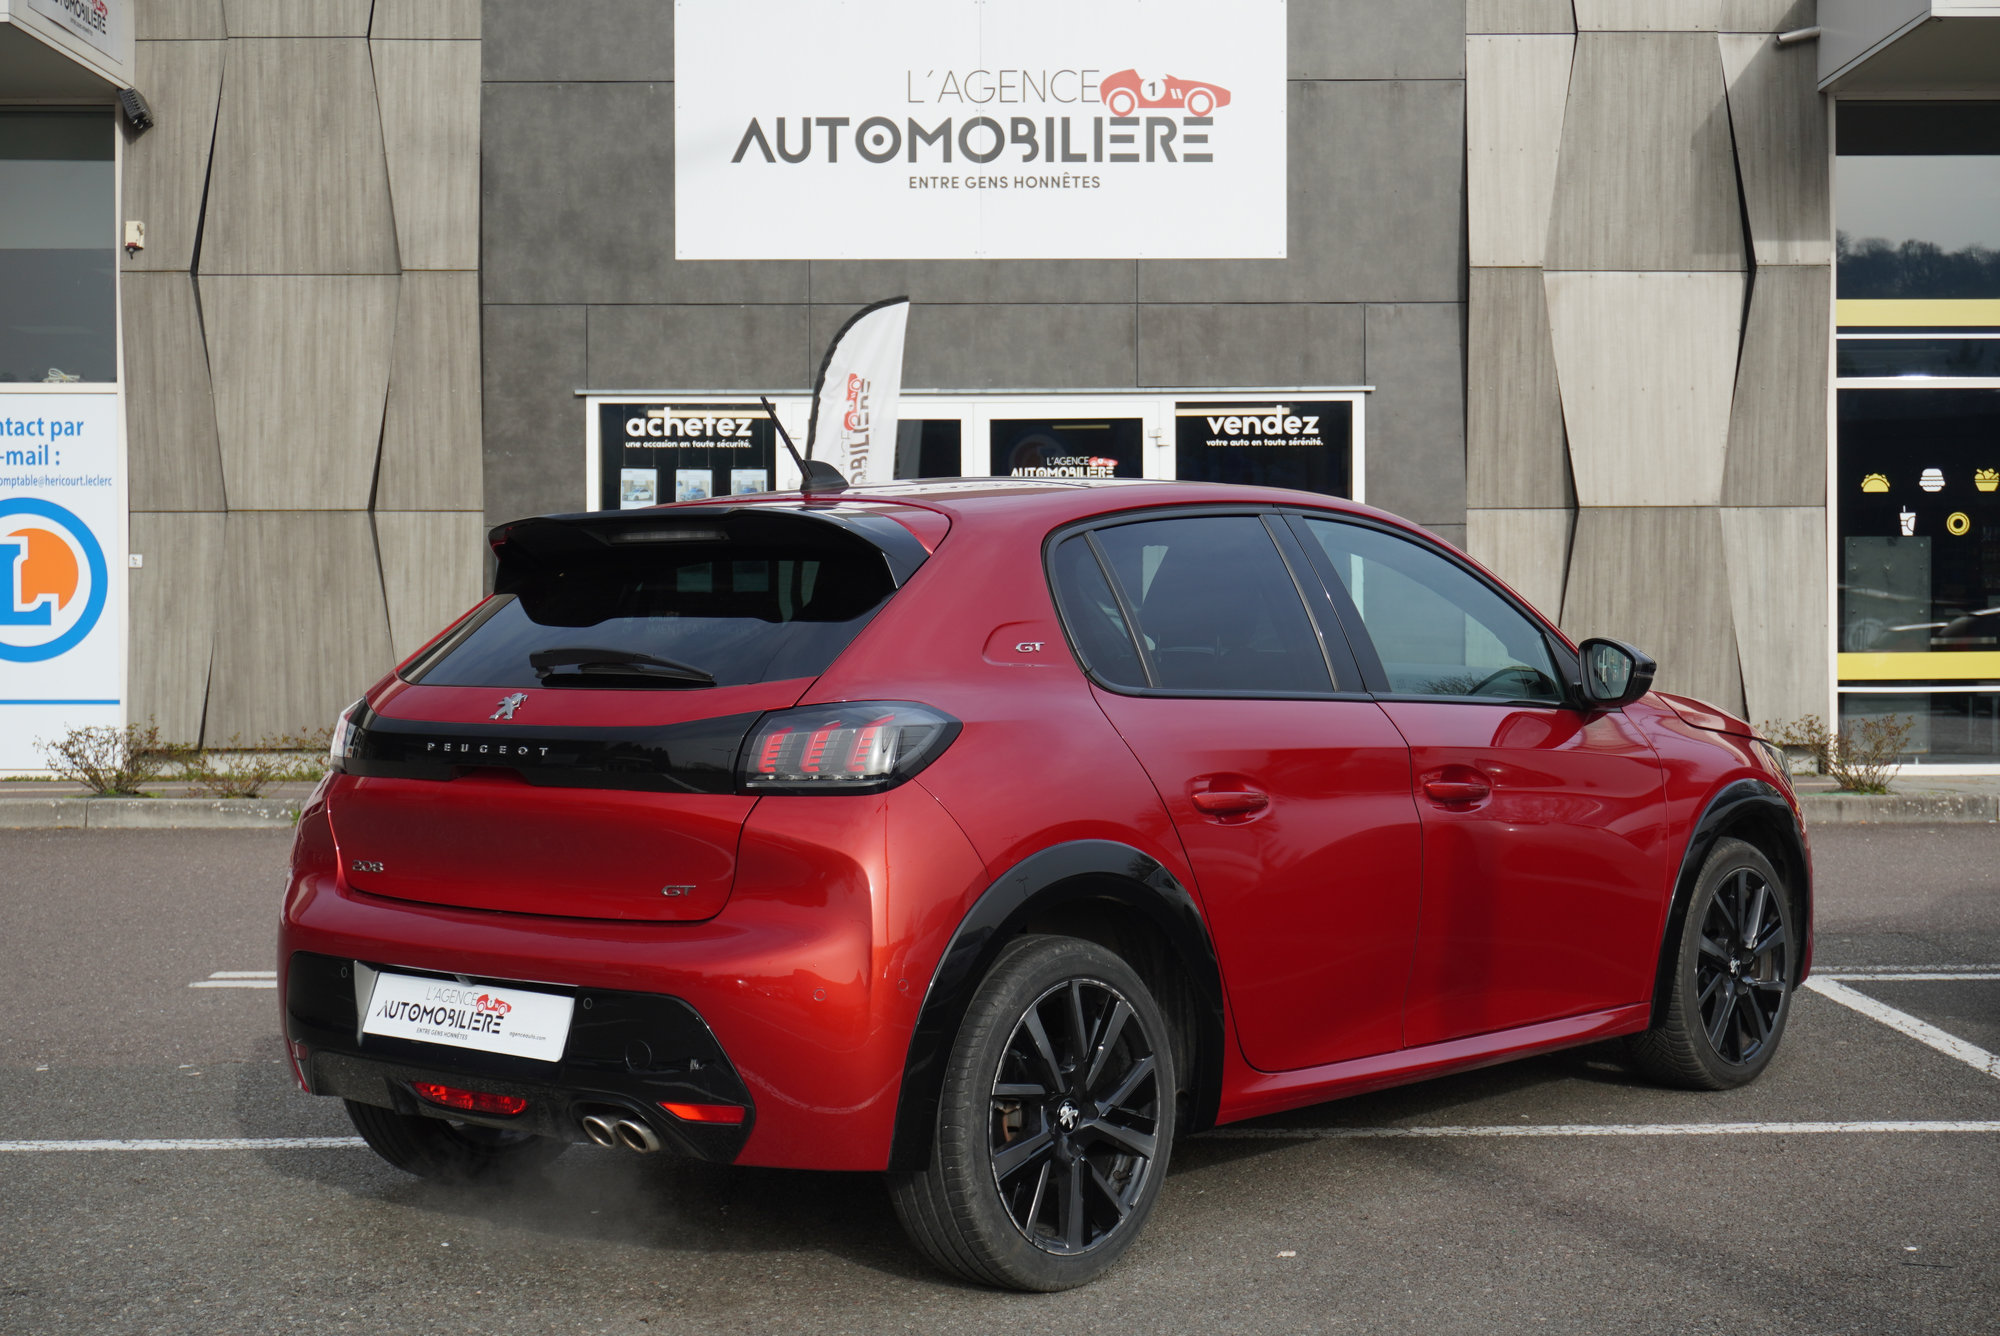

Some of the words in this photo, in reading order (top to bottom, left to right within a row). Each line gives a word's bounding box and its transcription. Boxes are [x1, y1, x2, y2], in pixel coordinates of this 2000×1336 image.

[907, 69, 1101, 104] L'AGENCE
[730, 116, 1214, 164] AUTOMOBILIERE
[908, 176, 960, 190] ENTRE
[964, 176, 1009, 190] GENS
[1013, 171, 1101, 190] HONNÊTES
[625, 406, 753, 437] achetez
[1206, 404, 1320, 436] vendez
[50, 420, 85, 442] par
[642, 439, 677, 448] occasion
[692, 440, 714, 448] toute
[1206, 438, 1228, 446] votre
[1229, 438, 1250, 446] auto
[1264, 438, 1287, 446] toute
[1046, 456, 1090, 466] L'AGENCE
[1015, 641, 1046, 653] GT
[426, 742, 549, 757] PEUGEOT
[352, 860, 384, 873] 208
[661, 884, 696, 897] GT
[425, 985, 479, 1007] L'AGENCE
[376, 1000, 505, 1035] AUTOMOBILIERE
[416, 1027, 430, 1036] ENTRE
[431, 1029, 443, 1038] GENS
[508, 1031, 547, 1041] agenceauto.com
